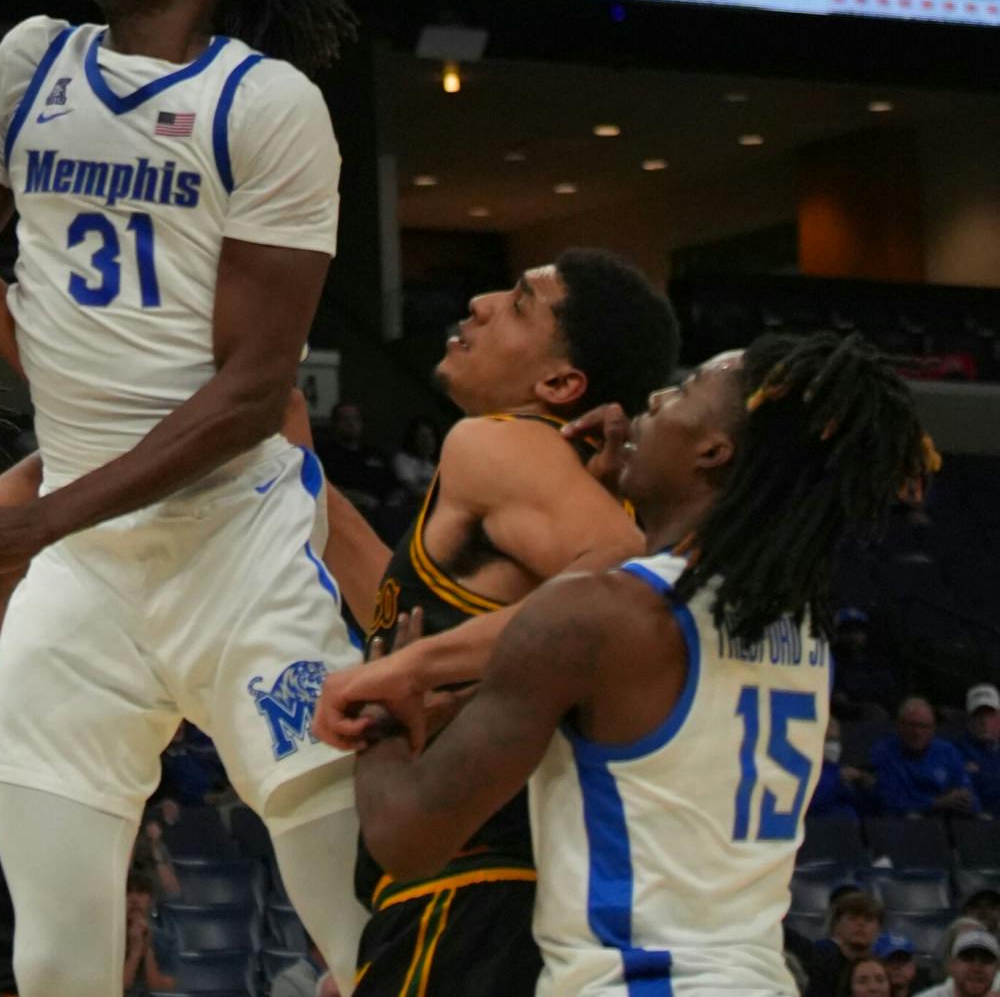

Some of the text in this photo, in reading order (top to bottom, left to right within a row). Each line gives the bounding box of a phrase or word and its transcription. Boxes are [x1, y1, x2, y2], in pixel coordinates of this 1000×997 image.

[24, 150, 201, 208] Memphis
[67, 212, 161, 308] 31
[733, 685, 817, 840] 15
